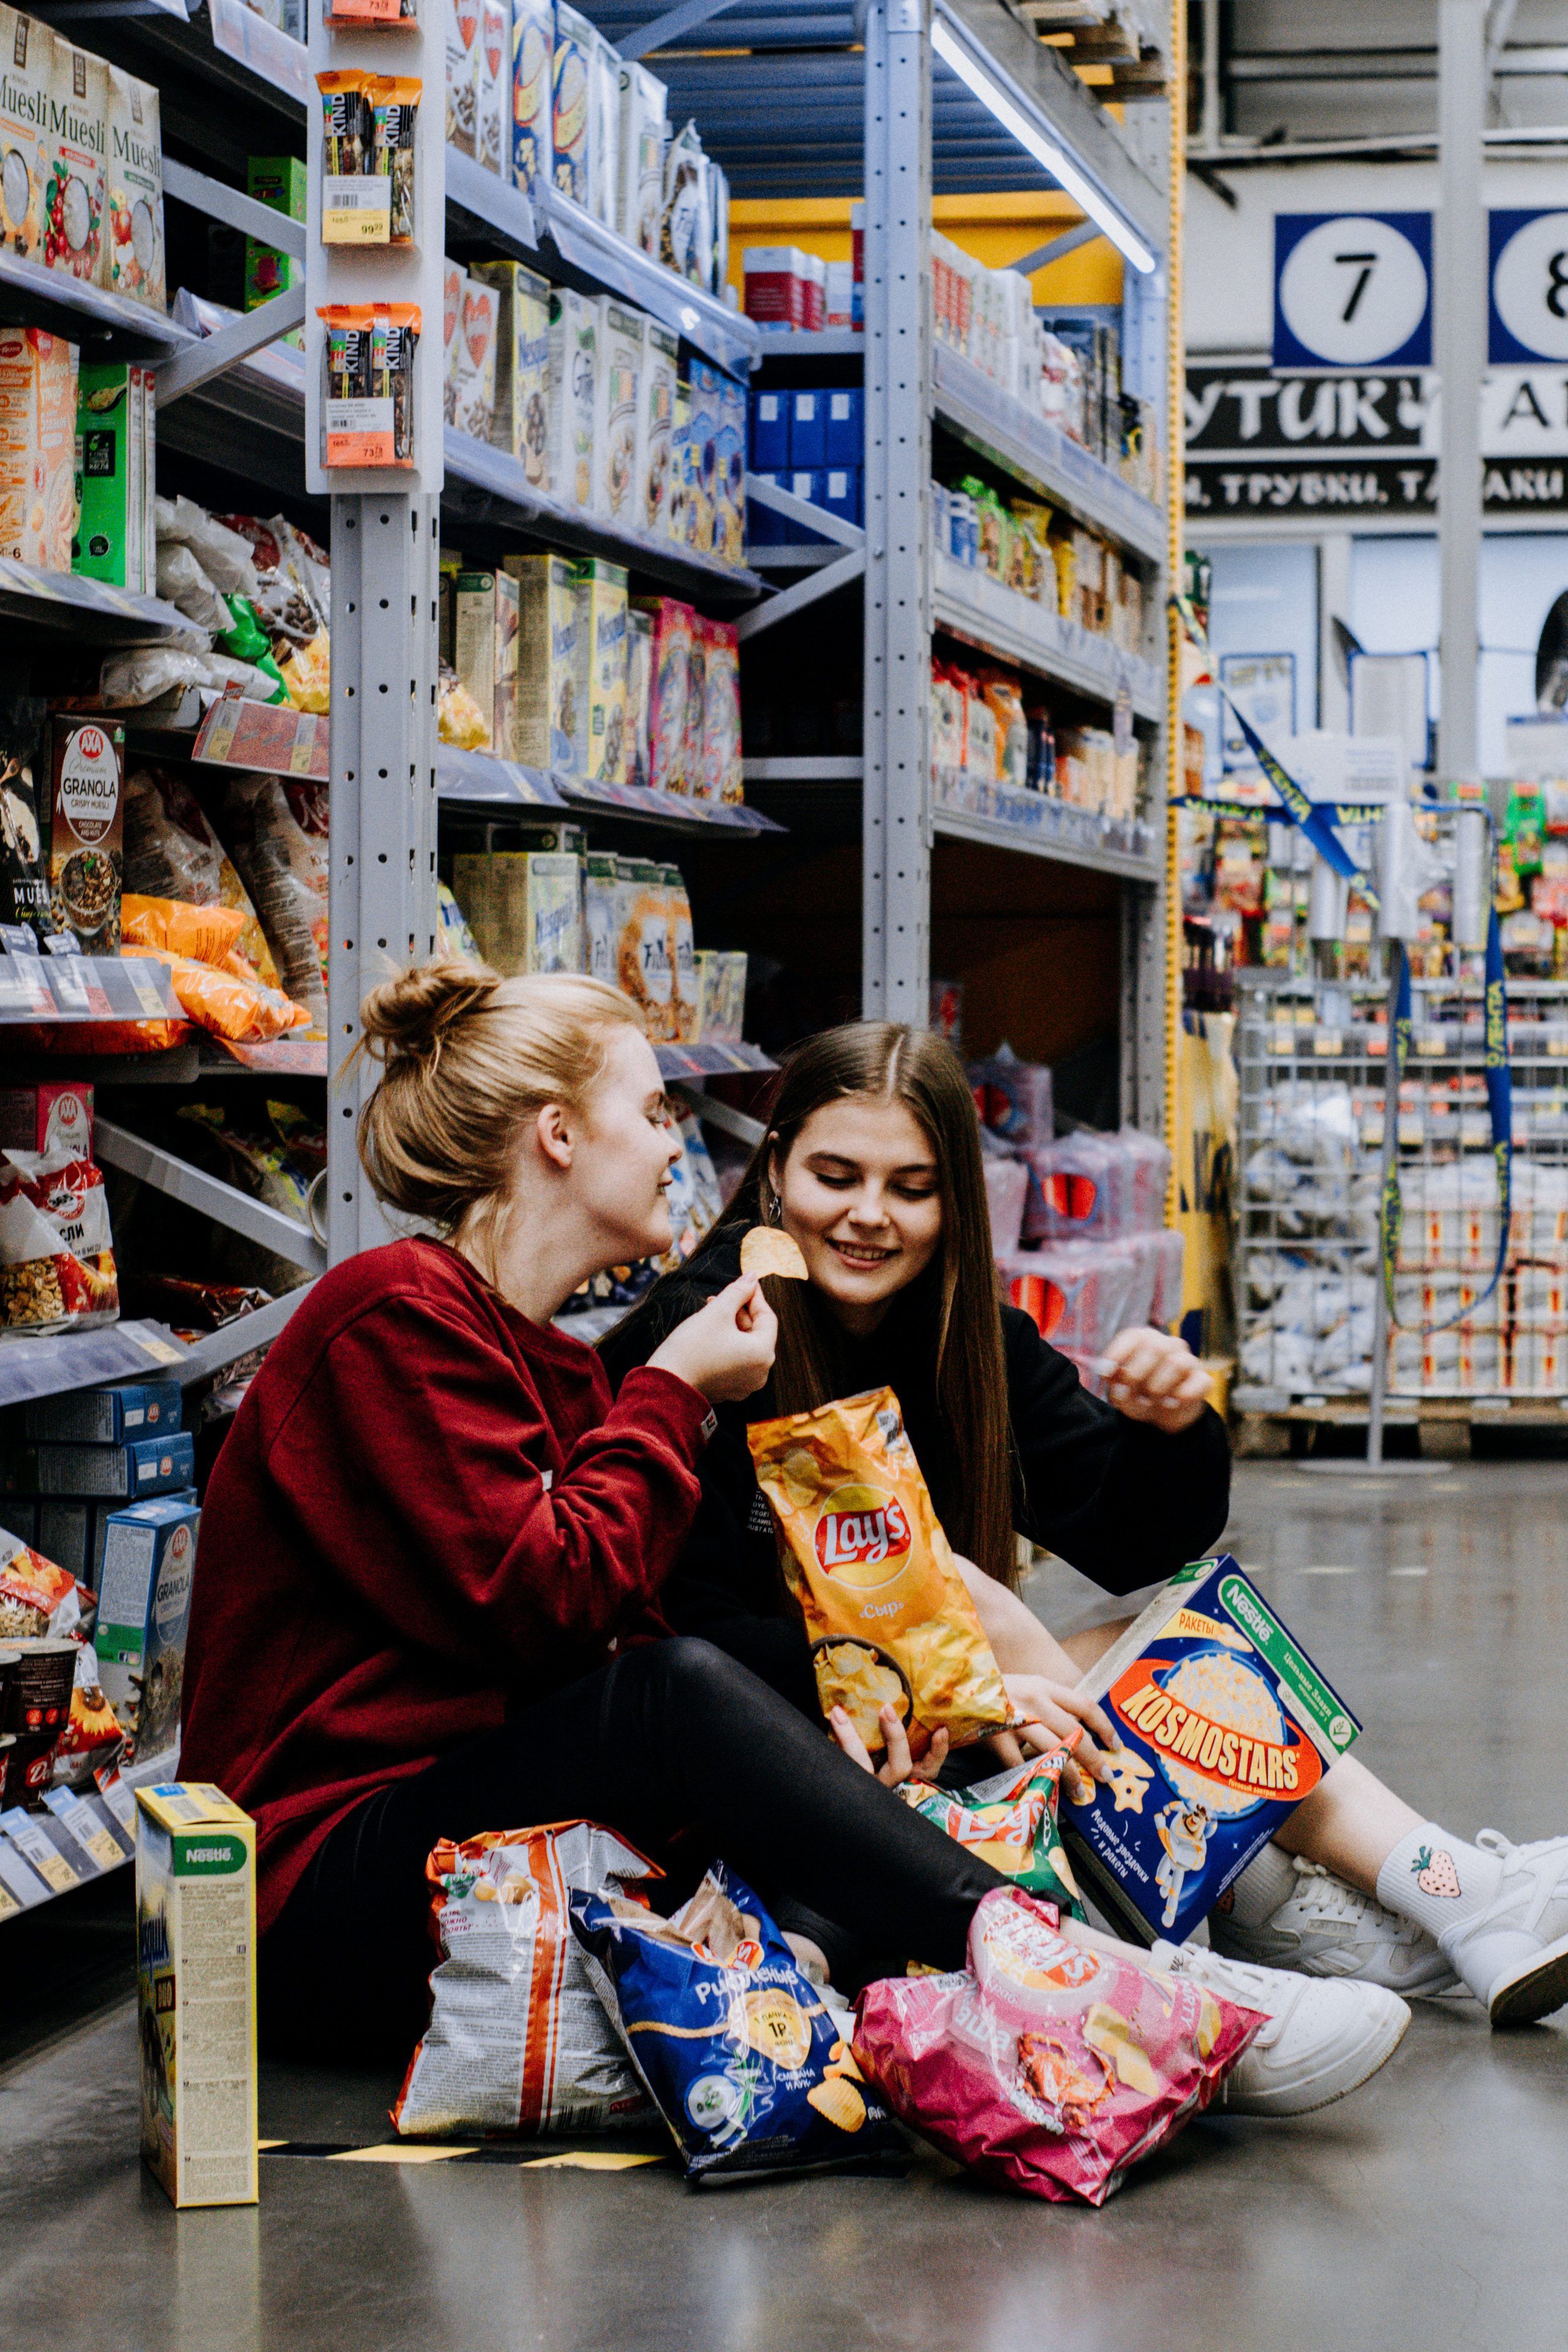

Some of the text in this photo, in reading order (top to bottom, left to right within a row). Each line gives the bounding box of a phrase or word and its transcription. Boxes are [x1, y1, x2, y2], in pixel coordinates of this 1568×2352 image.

[50, 99, 105, 153] Muesli
[333, 92, 347, 136] KIND
[385, 105, 401, 147] KIND
[113, 126, 161, 178] Muesli
[1335, 252, 1378, 322] 7
[1545, 251, 1568, 319] 8
[345, 330, 360, 372] KIND
[386, 326, 401, 369] KIND
[81, 731, 102, 753] AXA
[63, 777, 116, 798] GRANOLA
[69, 758, 107, 775] Premium
[71, 799, 110, 810] CRISPY MUESLI
[824, 1501, 905, 1566] Lay's
[157, 1573, 190, 1603] GRANOLA
[1178, 1612, 1215, 1635] РАКЕТЫ
[1283, 1651, 1332, 1717] Цельные Злаки
[1120, 1683, 1298, 1790] KOSMOSTARS
[1228, 1778, 1276, 1798] Готовый завтрак
[1091, 1808, 1150, 1883] Медовые звездочки
[1102, 1847, 1128, 1879] ракеты
[695, 1965, 799, 2005] Рифленые
[761, 2011, 788, 2021] ПАЧКА
